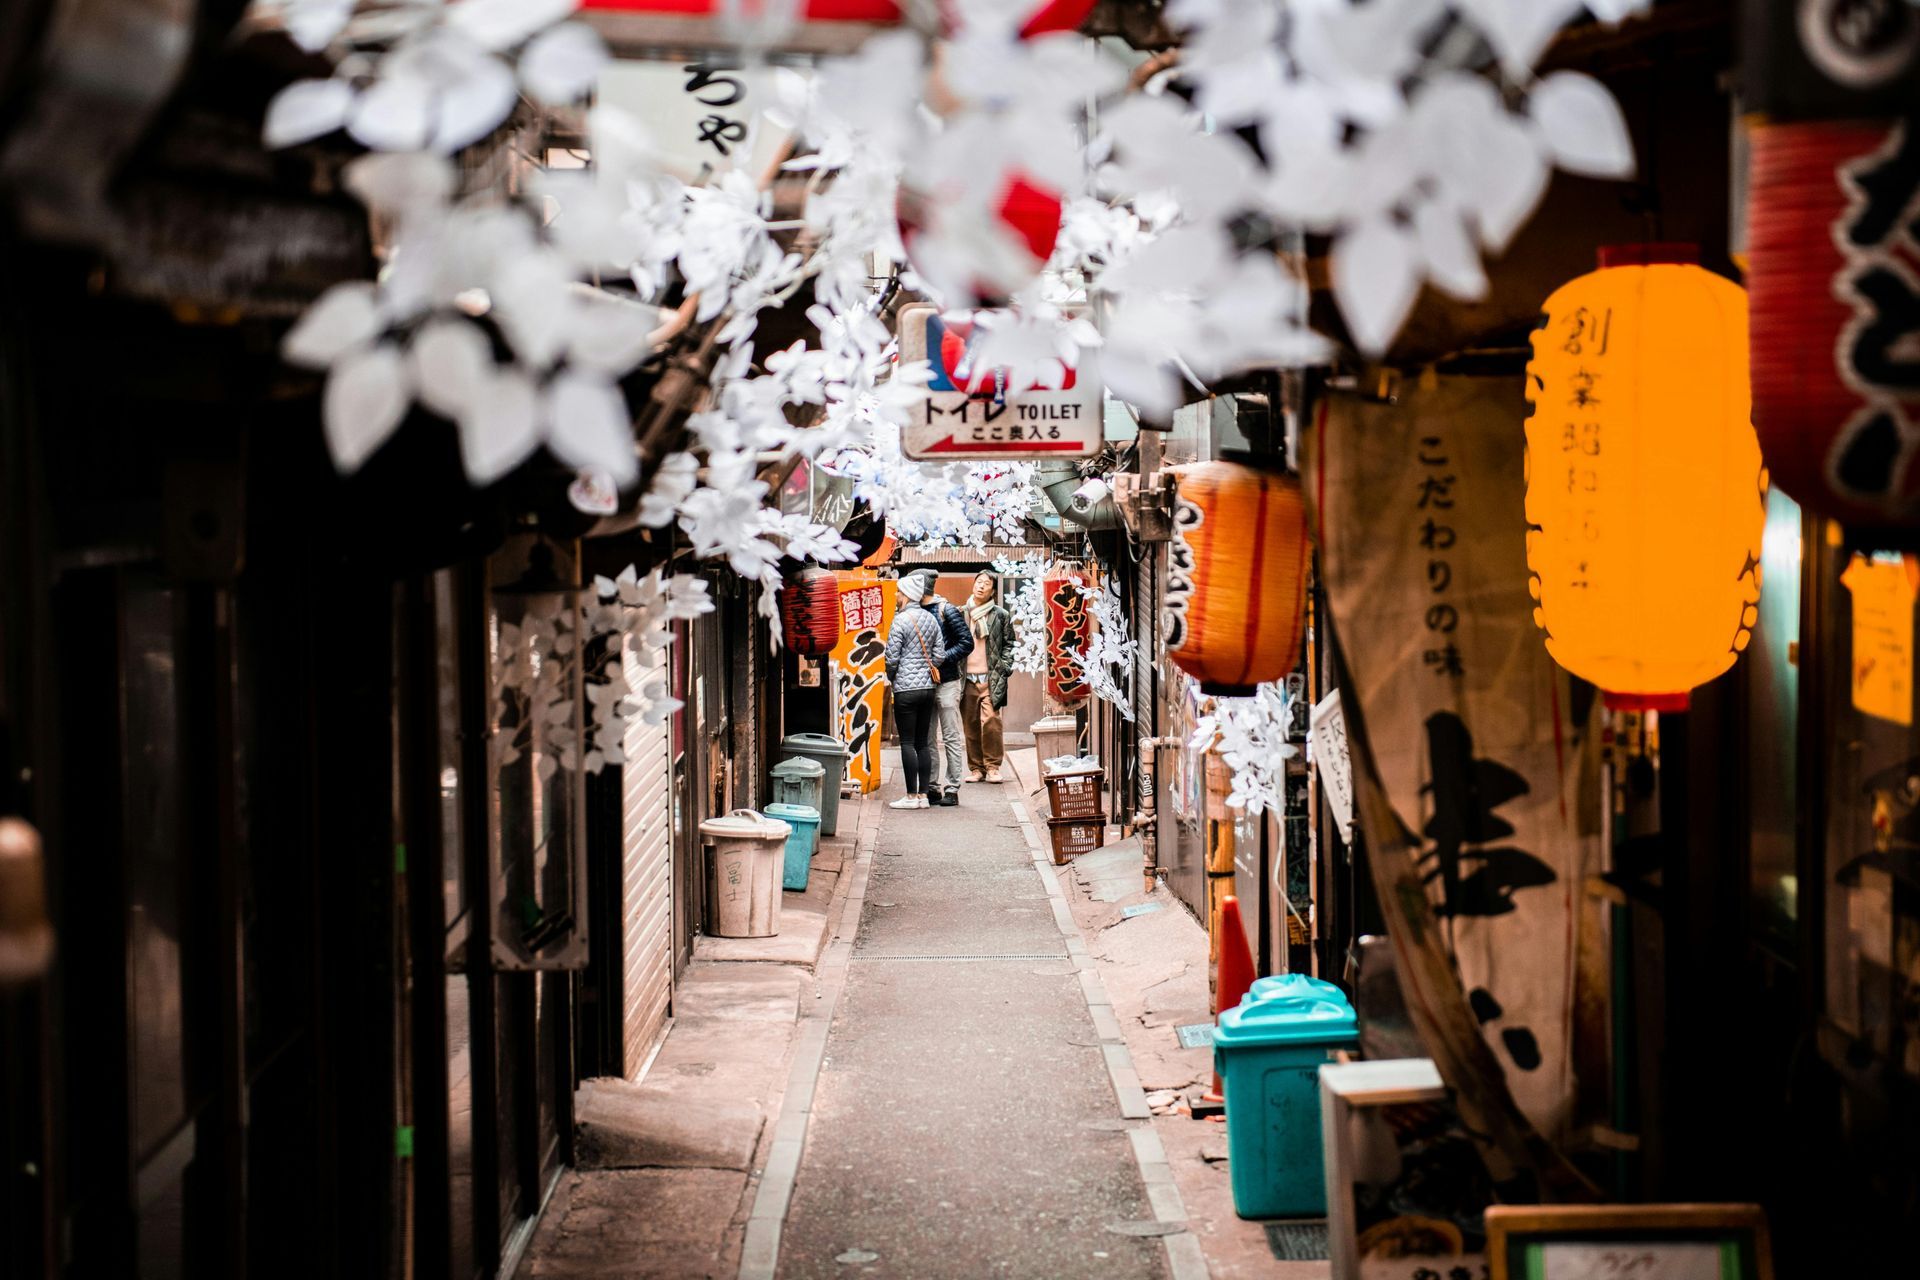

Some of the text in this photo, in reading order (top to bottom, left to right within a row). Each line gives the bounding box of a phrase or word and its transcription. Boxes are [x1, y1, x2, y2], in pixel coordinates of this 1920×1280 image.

[926, 397, 1082, 424] トイレ TOILET
[972, 425, 1061, 441] ここ奥入る
[1417, 436, 1465, 677] こだわりの味
[841, 592, 862, 632] 満足
[861, 587, 882, 627] 満腹
[846, 630, 885, 773] ランチ
